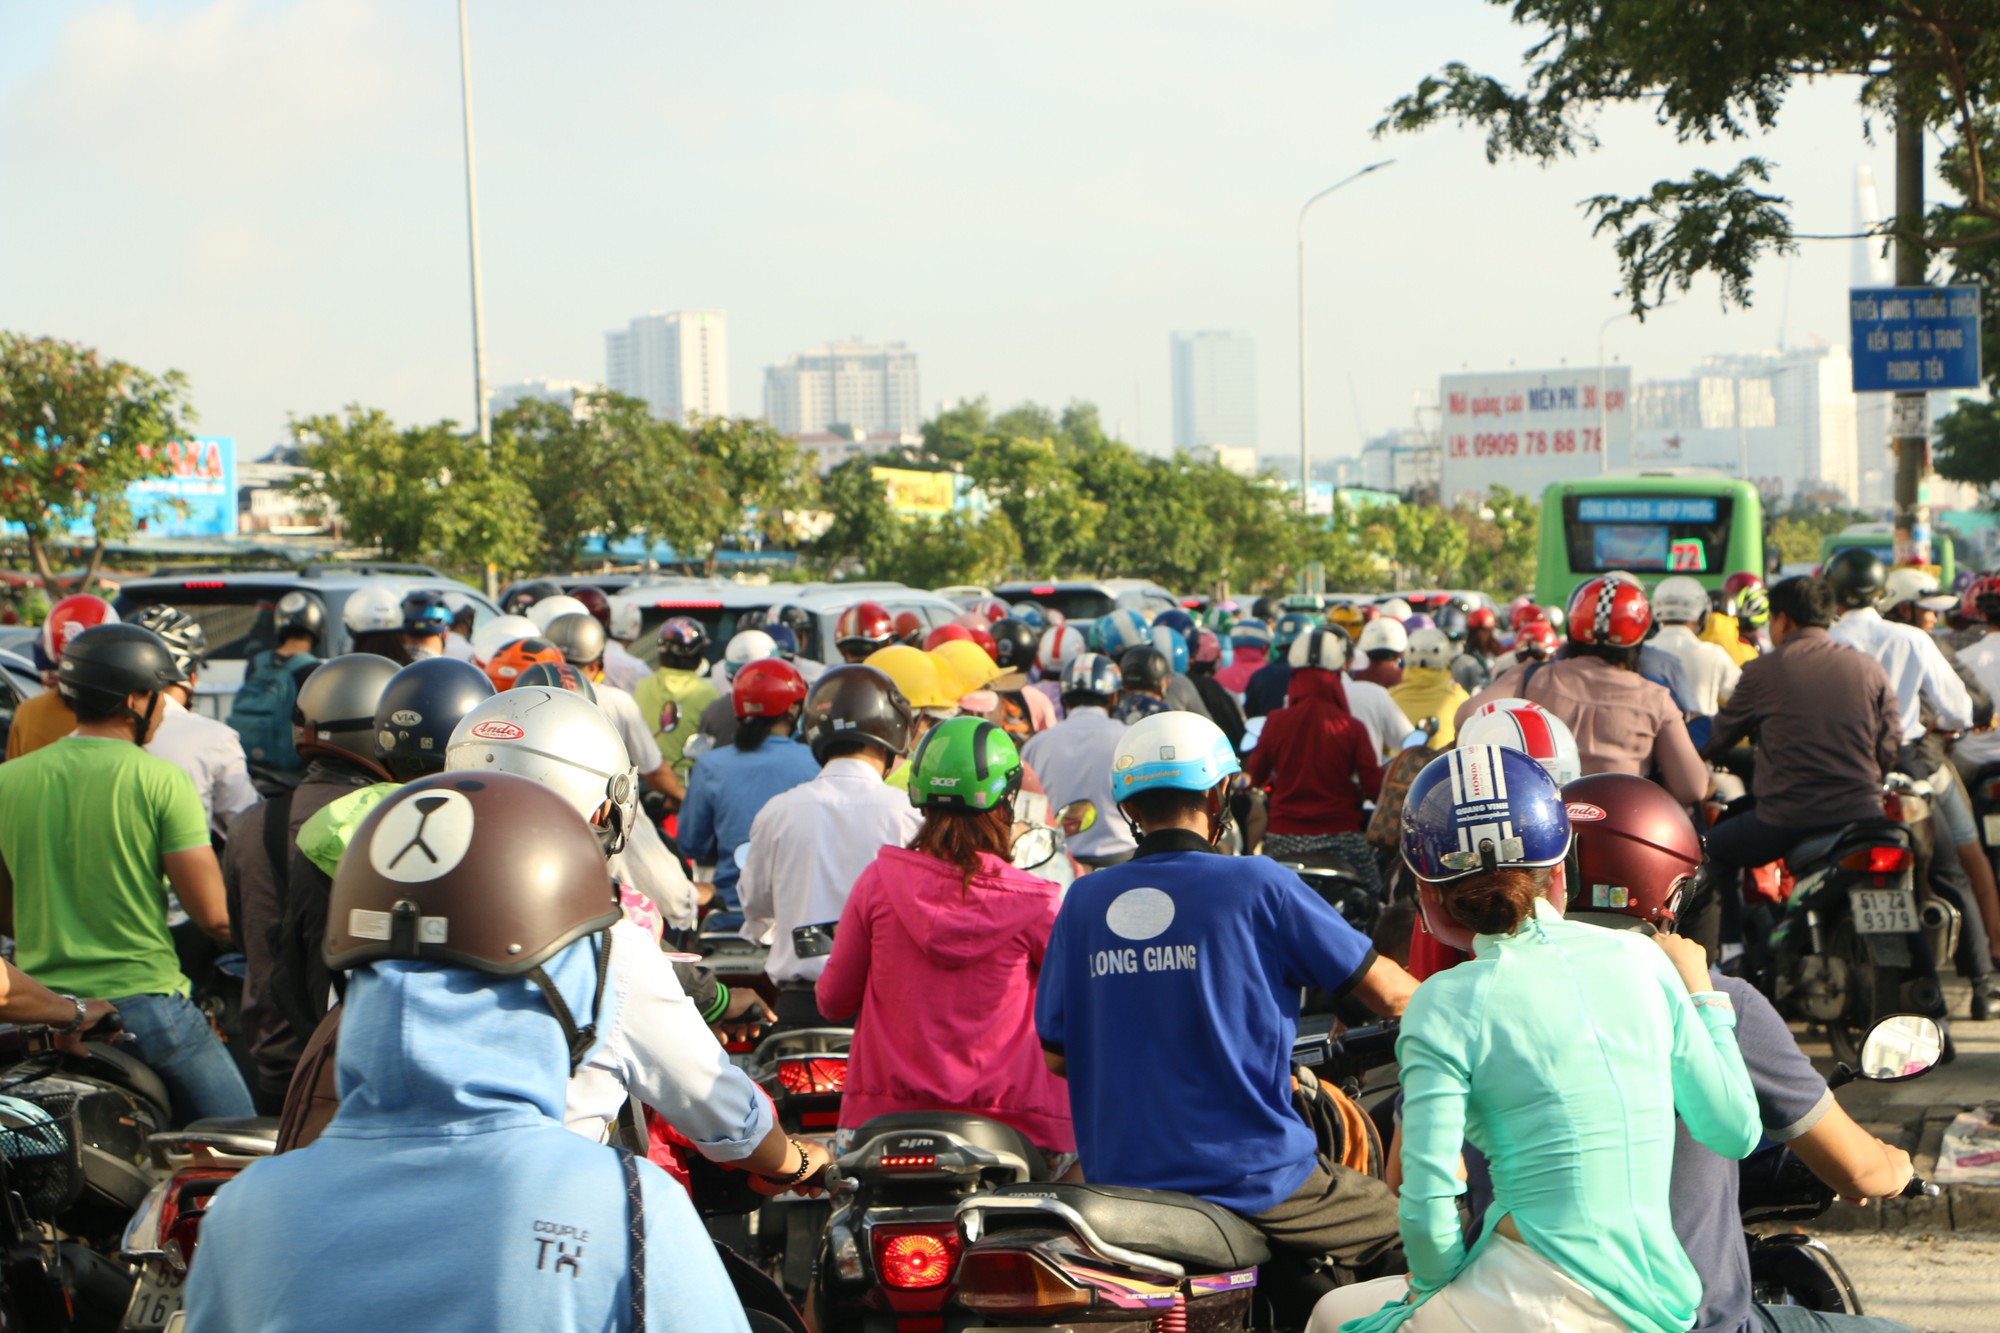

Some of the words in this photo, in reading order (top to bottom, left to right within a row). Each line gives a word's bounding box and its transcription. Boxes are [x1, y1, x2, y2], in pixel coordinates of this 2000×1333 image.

[930, 777, 960, 787] acer
[1470, 762, 1480, 796] HONDA
[1089, 948, 1138, 978] LONG
[1143, 944, 1197, 972] GIANG
